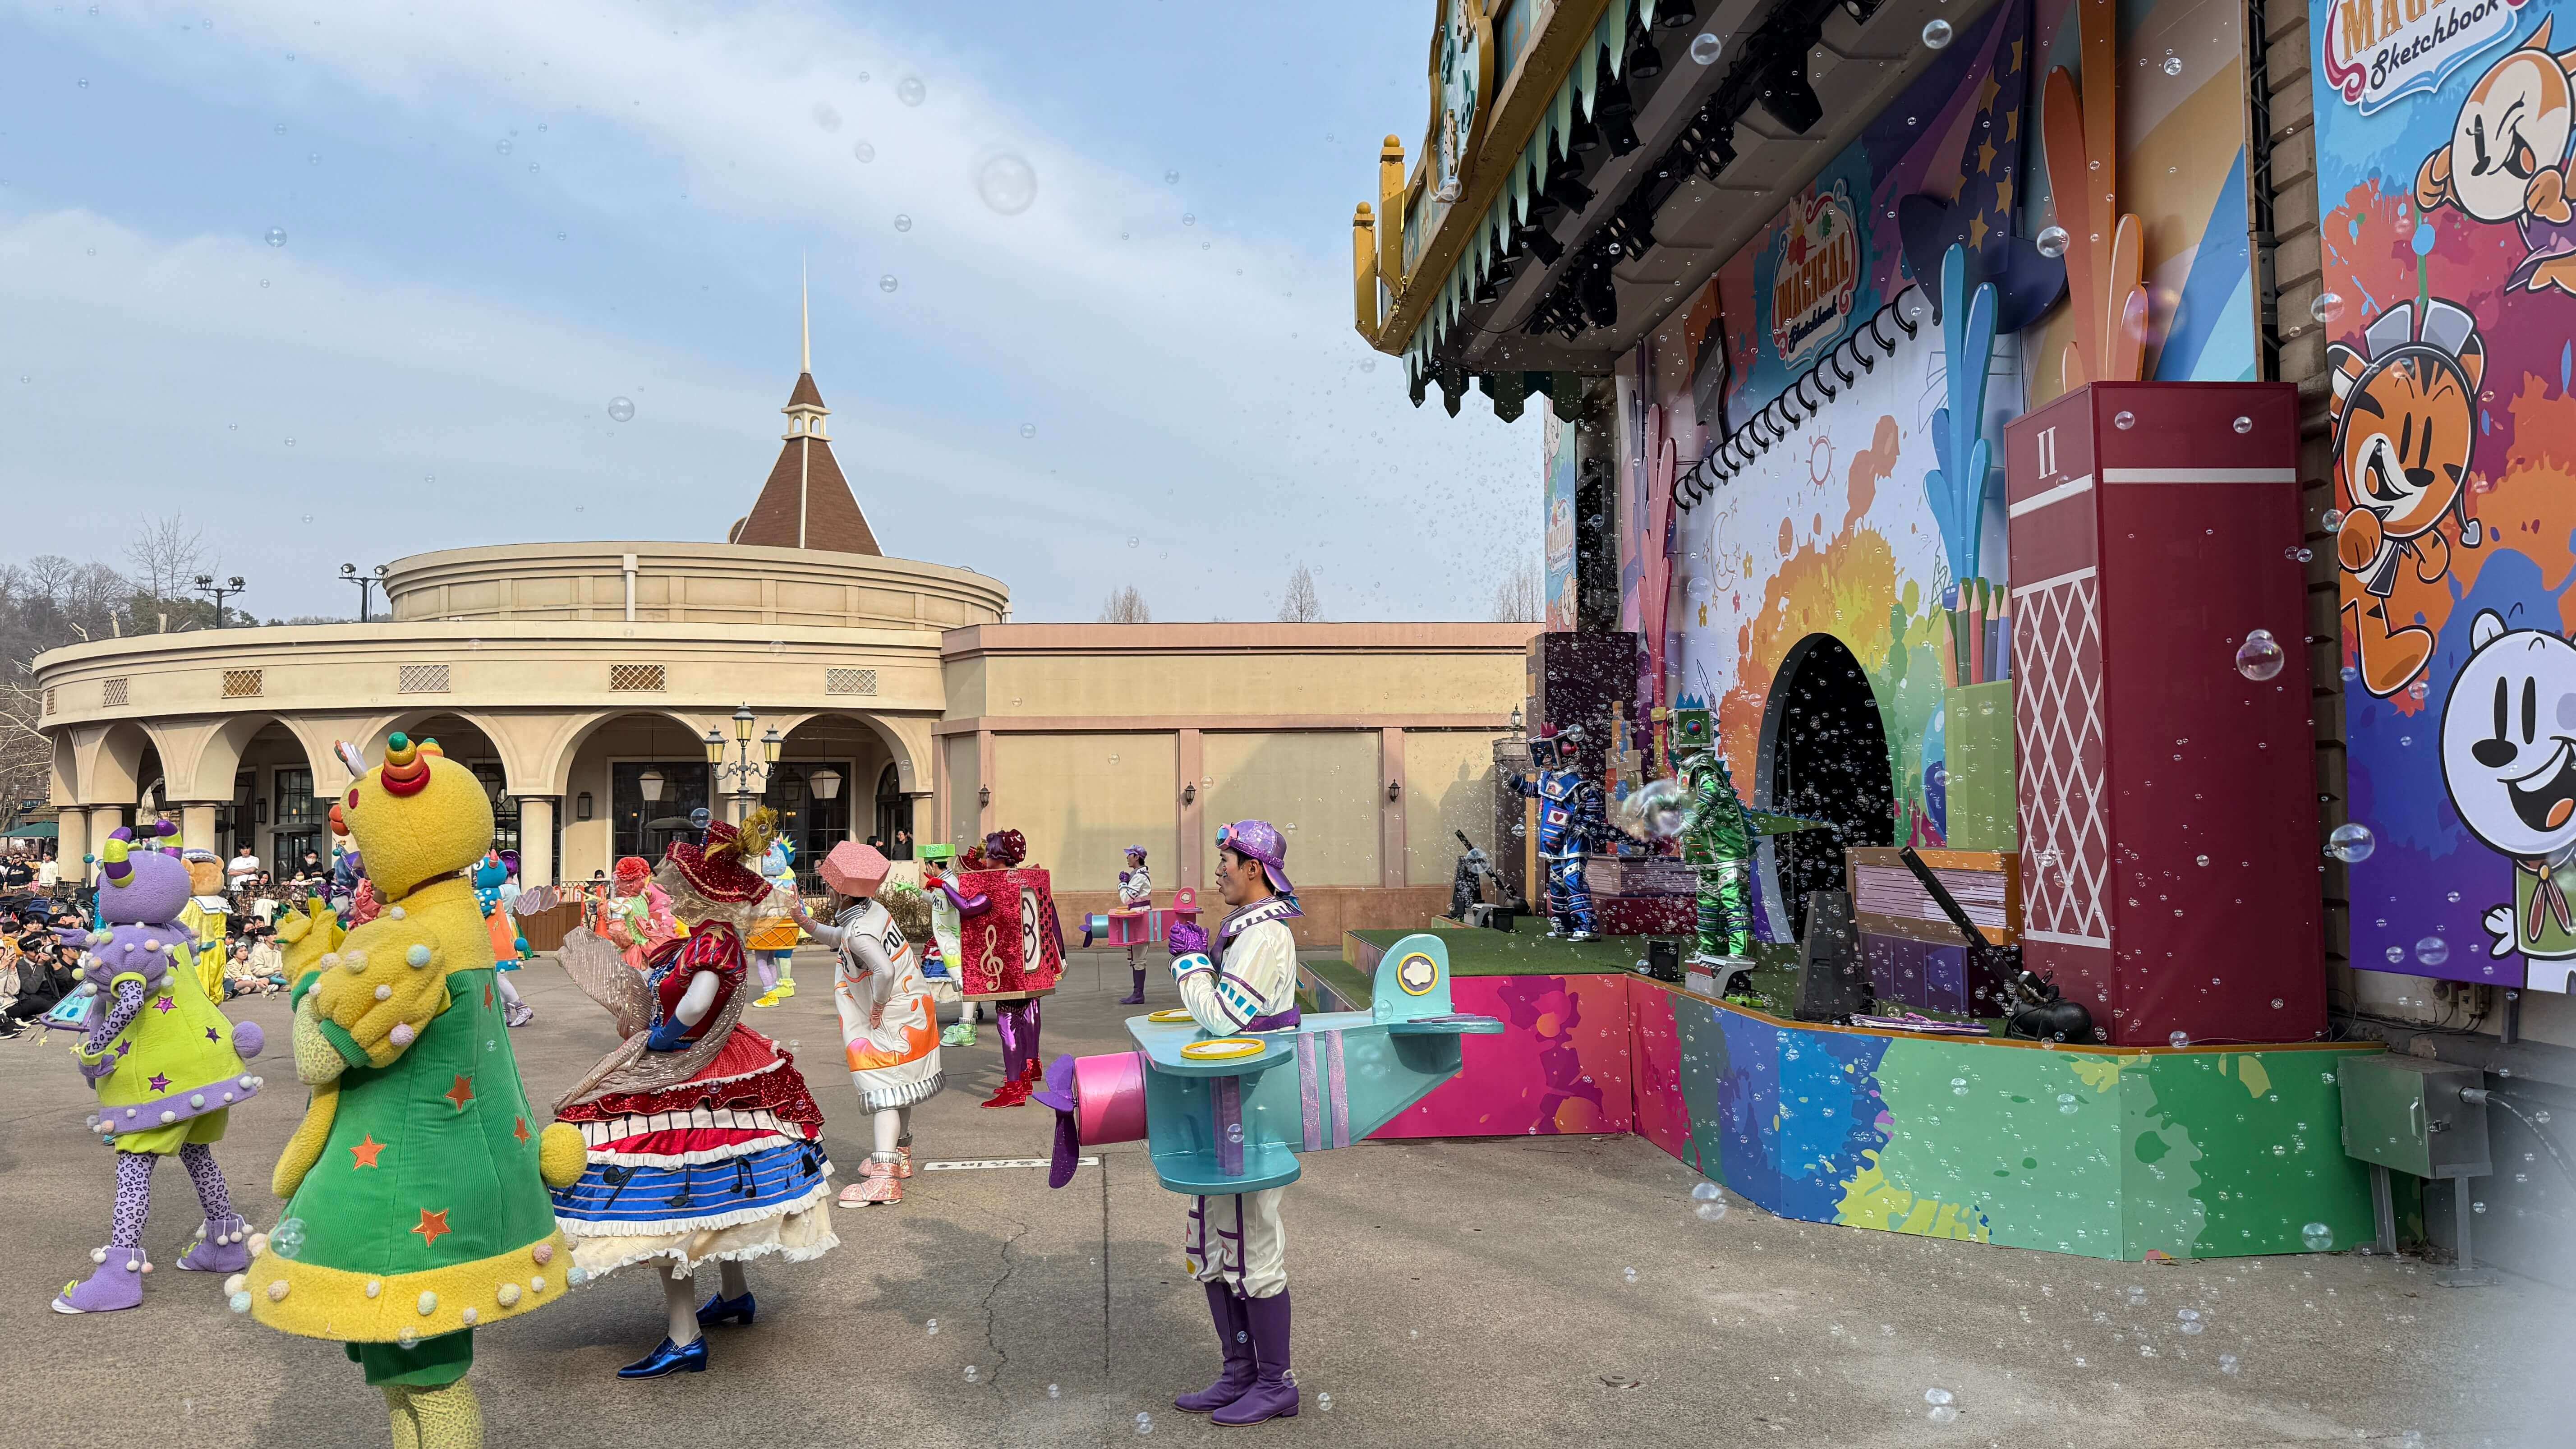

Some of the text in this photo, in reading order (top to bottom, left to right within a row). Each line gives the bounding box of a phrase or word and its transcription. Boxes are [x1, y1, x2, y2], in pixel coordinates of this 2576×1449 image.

[2340, 0, 2446, 64] MA
[1777, 232, 1849, 327] MAGICAL
[1788, 295, 1838, 354] Sketchbook
